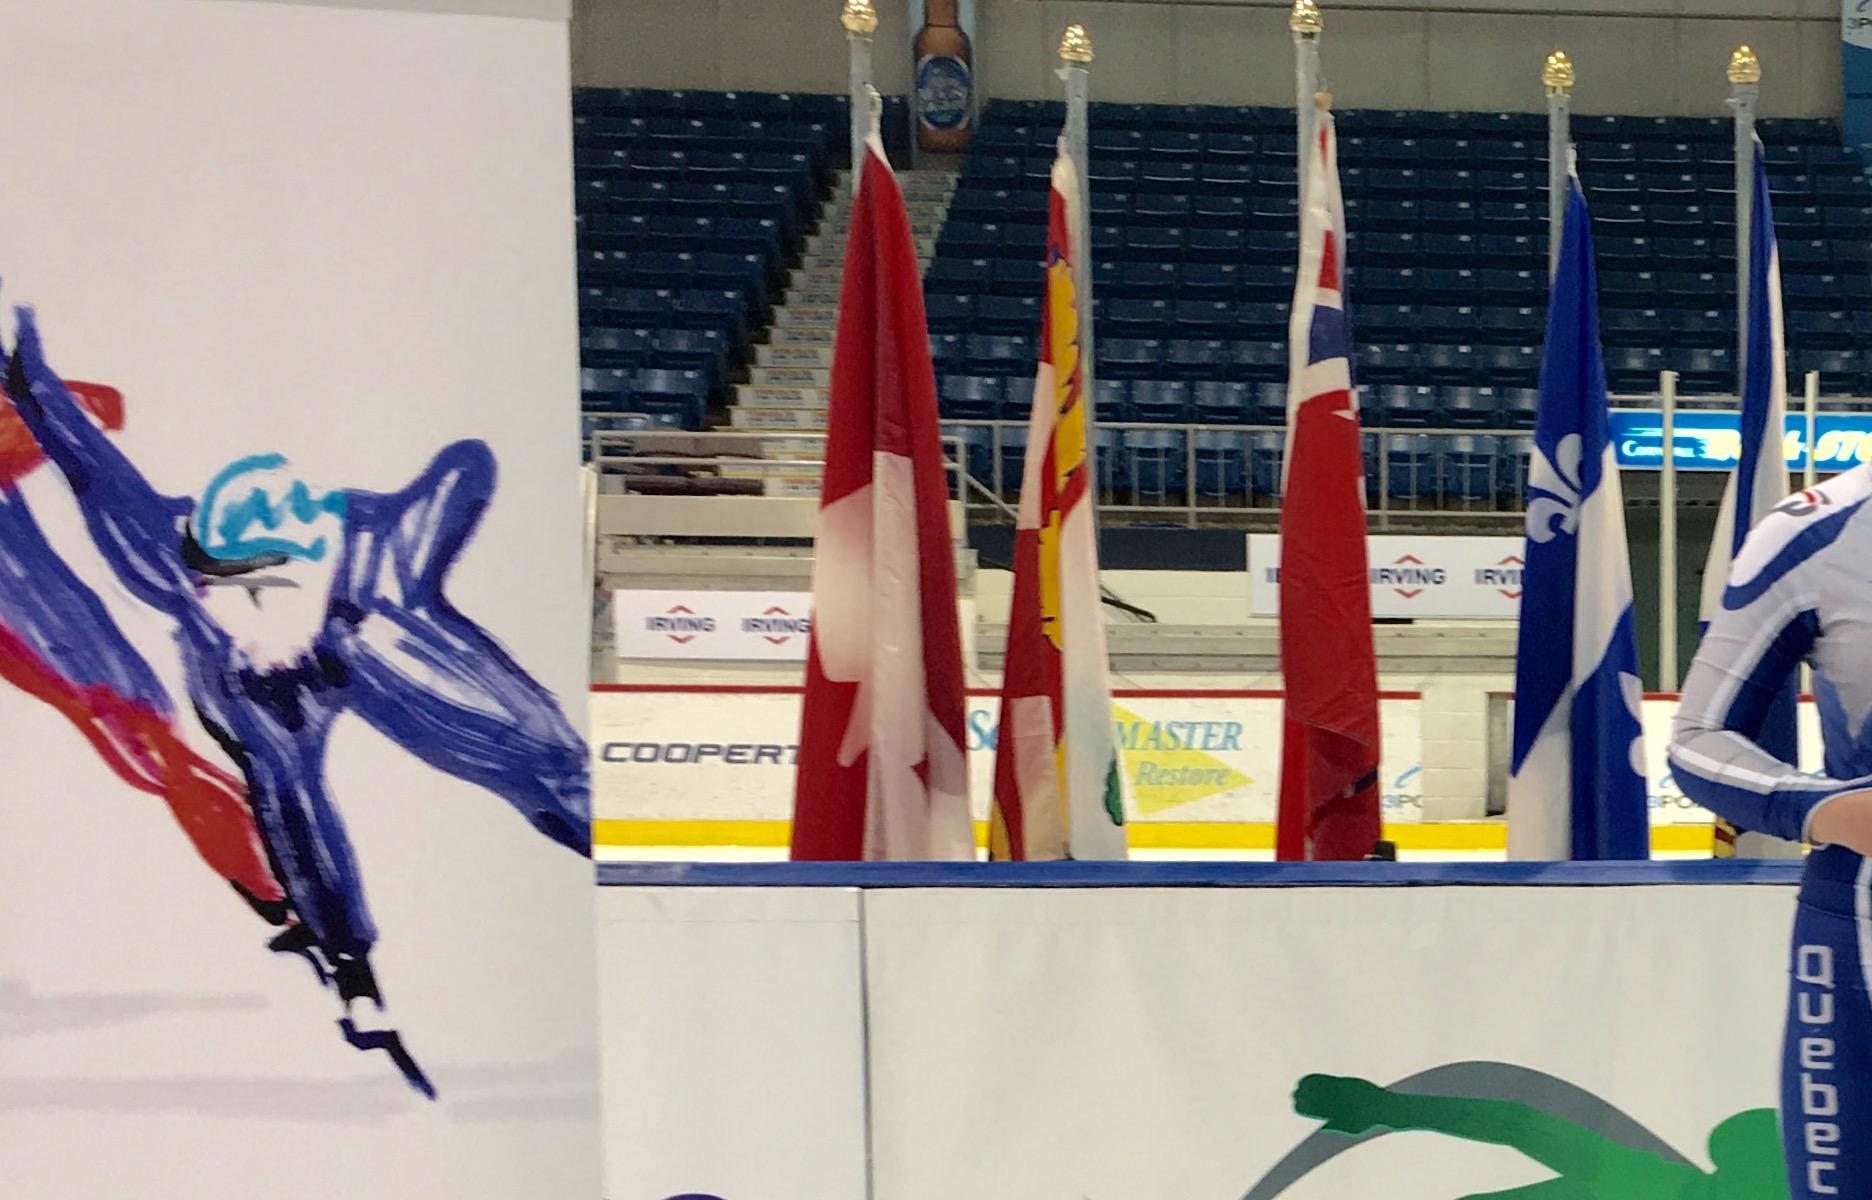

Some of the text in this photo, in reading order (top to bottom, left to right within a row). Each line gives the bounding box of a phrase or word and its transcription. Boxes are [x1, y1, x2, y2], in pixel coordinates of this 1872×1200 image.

[1371, 567, 1446, 585] IRVING
[1474, 567, 1523, 585] IRVI
[646, 616, 716, 632] IRVING
